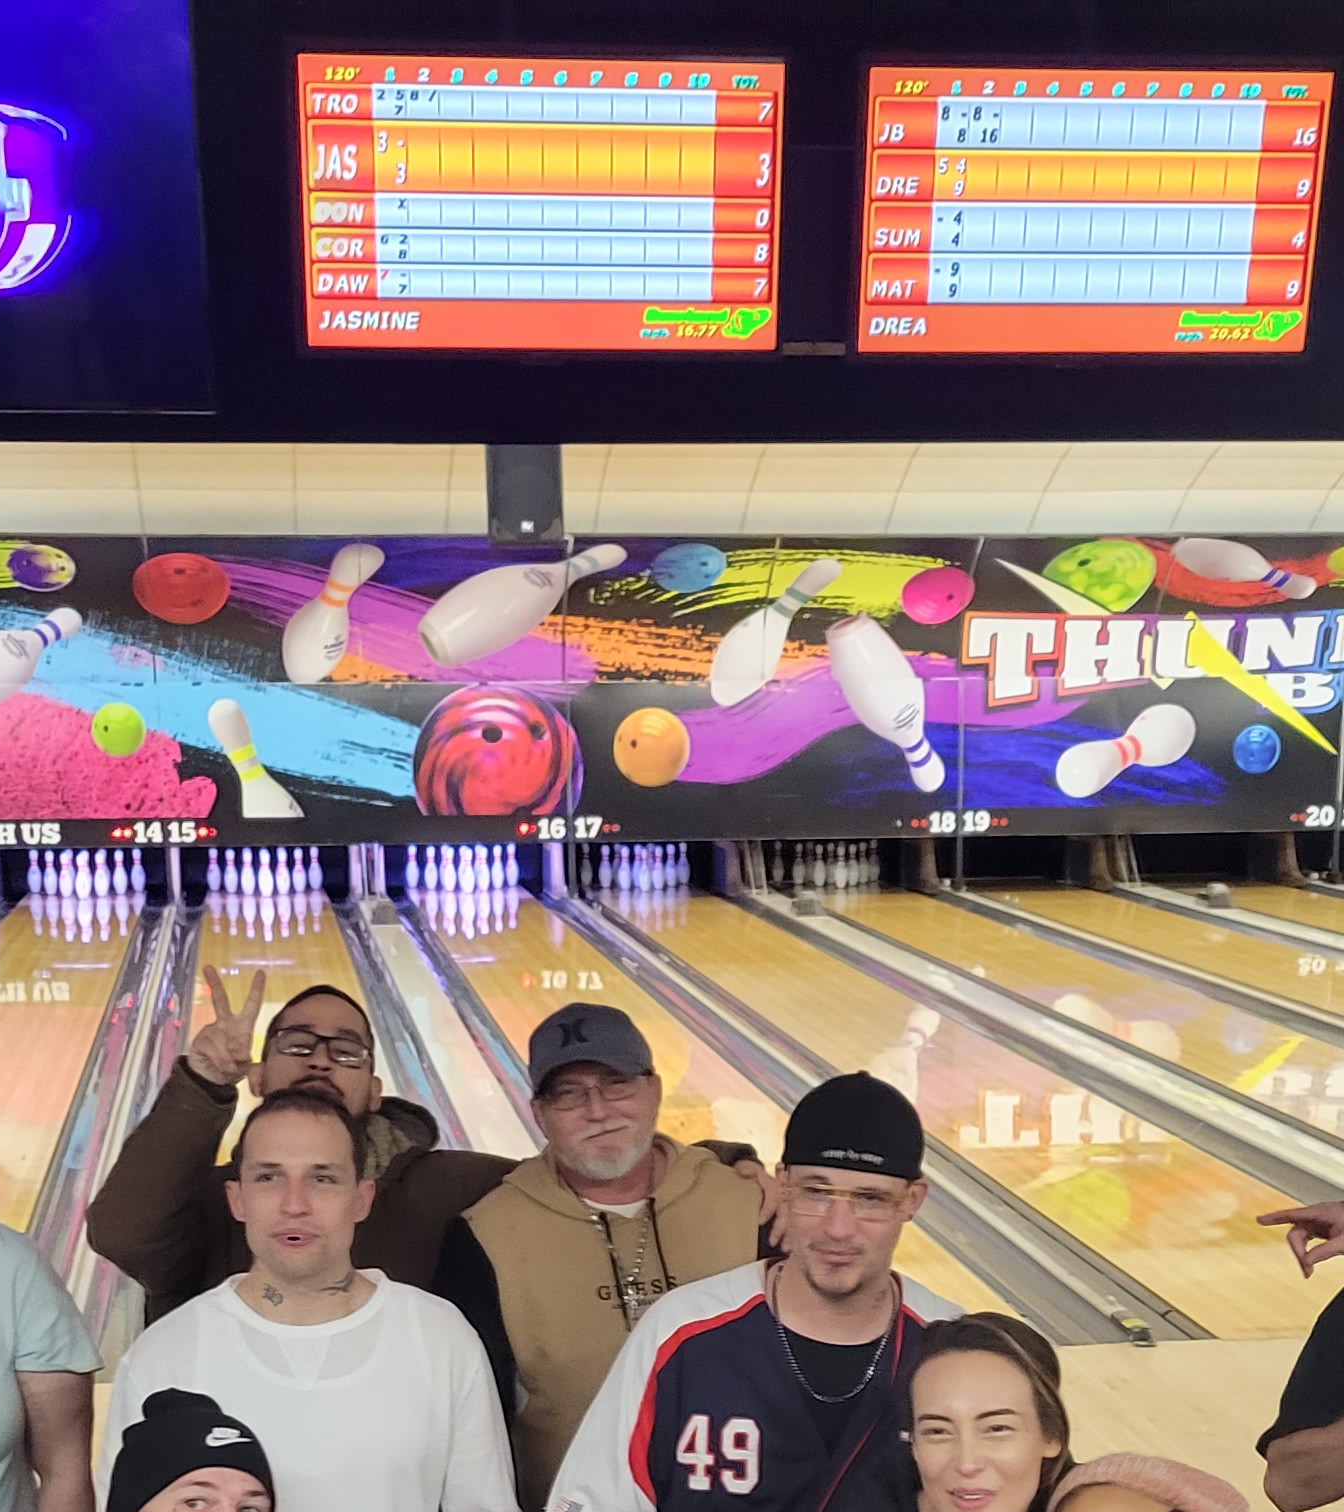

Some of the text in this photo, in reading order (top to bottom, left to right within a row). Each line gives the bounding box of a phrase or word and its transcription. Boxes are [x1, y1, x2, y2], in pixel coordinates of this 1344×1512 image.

[418, 67, 430, 82] 2
[982, 80, 995, 95] 2
[311, 92, 359, 114] TRO
[758, 101, 773, 122] 7
[878, 105, 1318, 147] JB 8 8 16
[957, 127, 998, 143] 8 16
[313, 130, 771, 188] JAS 3 3
[395, 162, 406, 184] 3
[875, 157, 1311, 199] DRE 5 4 9
[954, 179, 964, 197] 9
[314, 201, 365, 223] DON
[755, 208, 770, 229] 0
[873, 210, 1306, 250] SUM 4 4
[951, 232, 960, 248] 4
[315, 237, 364, 258] COR
[754, 243, 769, 263] 8
[316, 273, 369, 294] DAW
[753, 279, 769, 299] 7
[871, 262, 1300, 300] MAT 9 9
[948, 283, 958, 298] 9
[318, 309, 421, 332] JASMINE
[868, 315, 928, 337] DREA
[536, 816, 604, 840] 16 17
[928, 810, 992, 834] 18 19
[1304, 805, 1336, 828] 20
[21, 822, 61, 845] US
[133, 822, 199, 843] 14 15
[675, 1413, 762, 1496] 49
